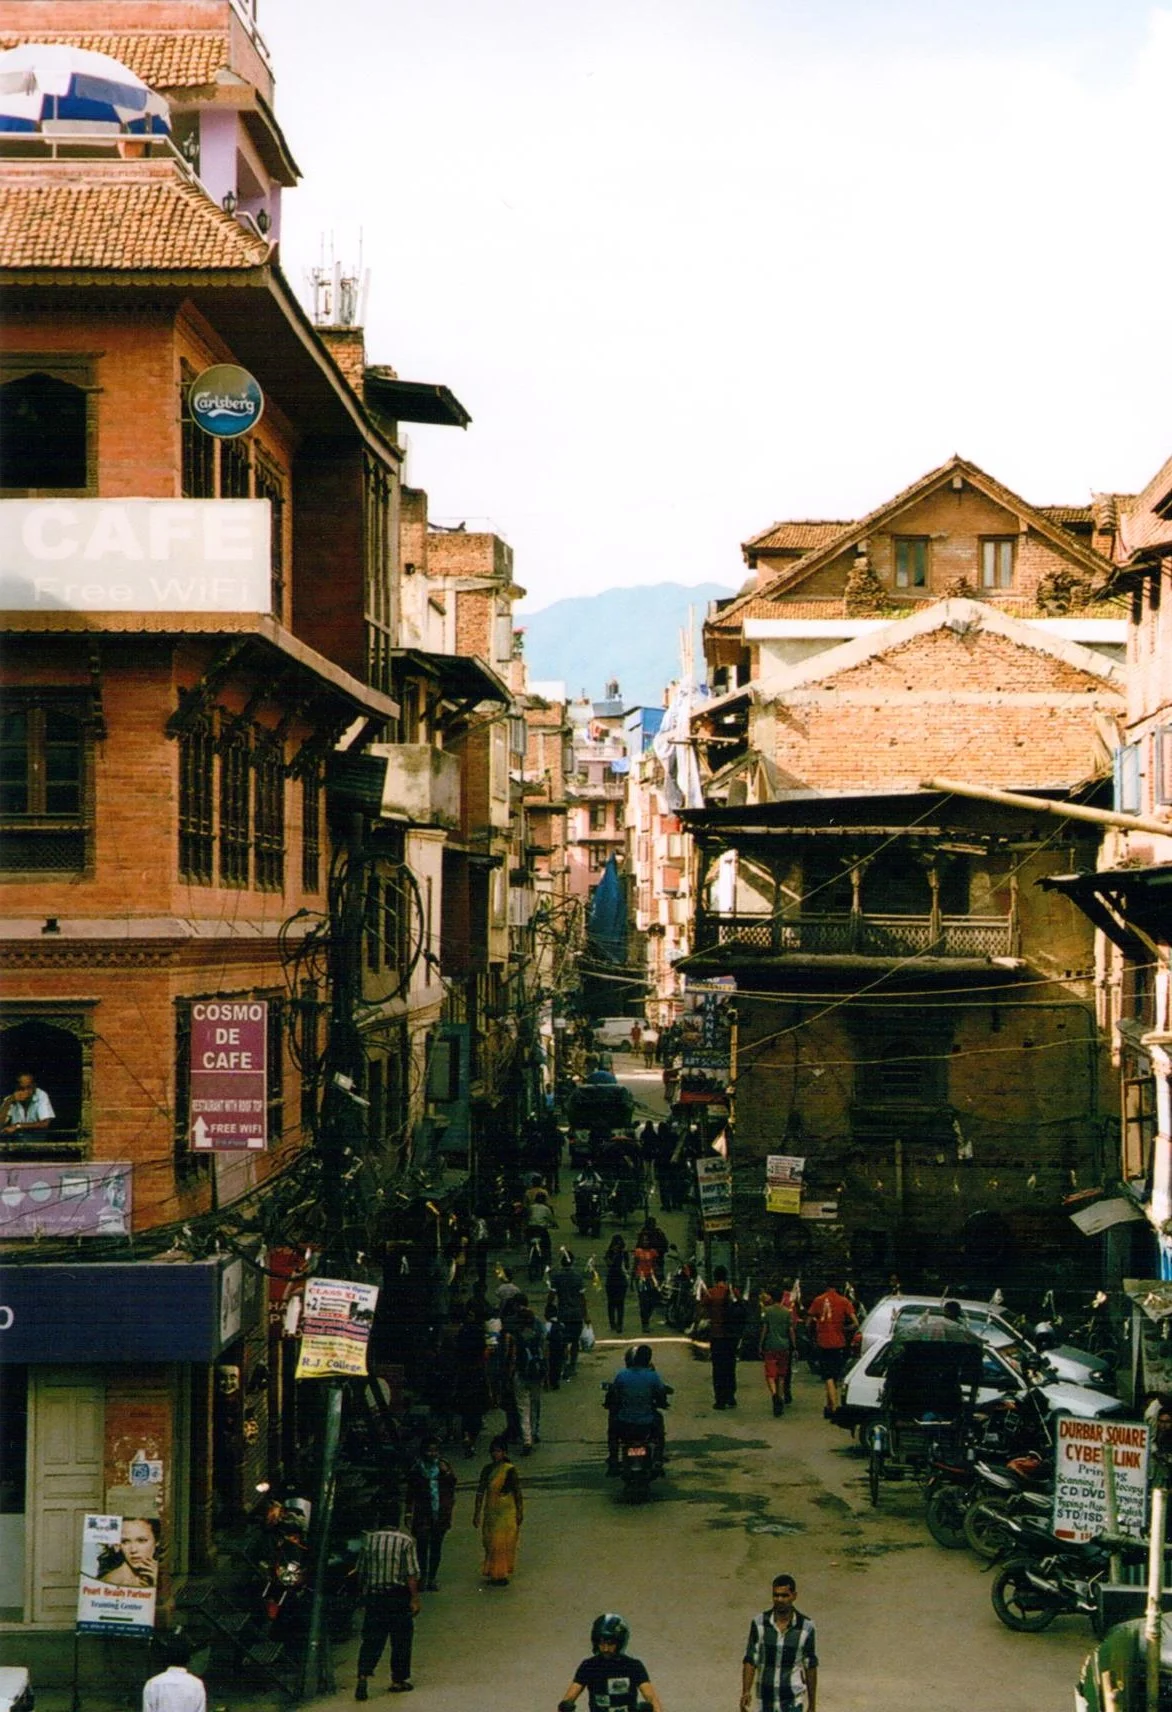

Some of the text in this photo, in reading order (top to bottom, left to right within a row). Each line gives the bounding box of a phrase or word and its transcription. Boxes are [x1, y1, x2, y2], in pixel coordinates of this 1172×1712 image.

[194, 392, 255, 415] Carlsberg
[22, 505, 253, 561] CAFE
[33, 577, 248, 603] Free WiFi
[193, 1004, 262, 1021] COSMO
[215, 1028, 240, 1045] DE
[203, 1052, 252, 1069] CAFE
[210, 1124, 262, 1134] FREE WIFI
[308, 1288, 342, 1296] CLASS
[326, 1359, 362, 1372] College
[1059, 1421, 1147, 1448] DURBAR SQUARE
[1066, 1443, 1141, 1469] CYBE LINK
